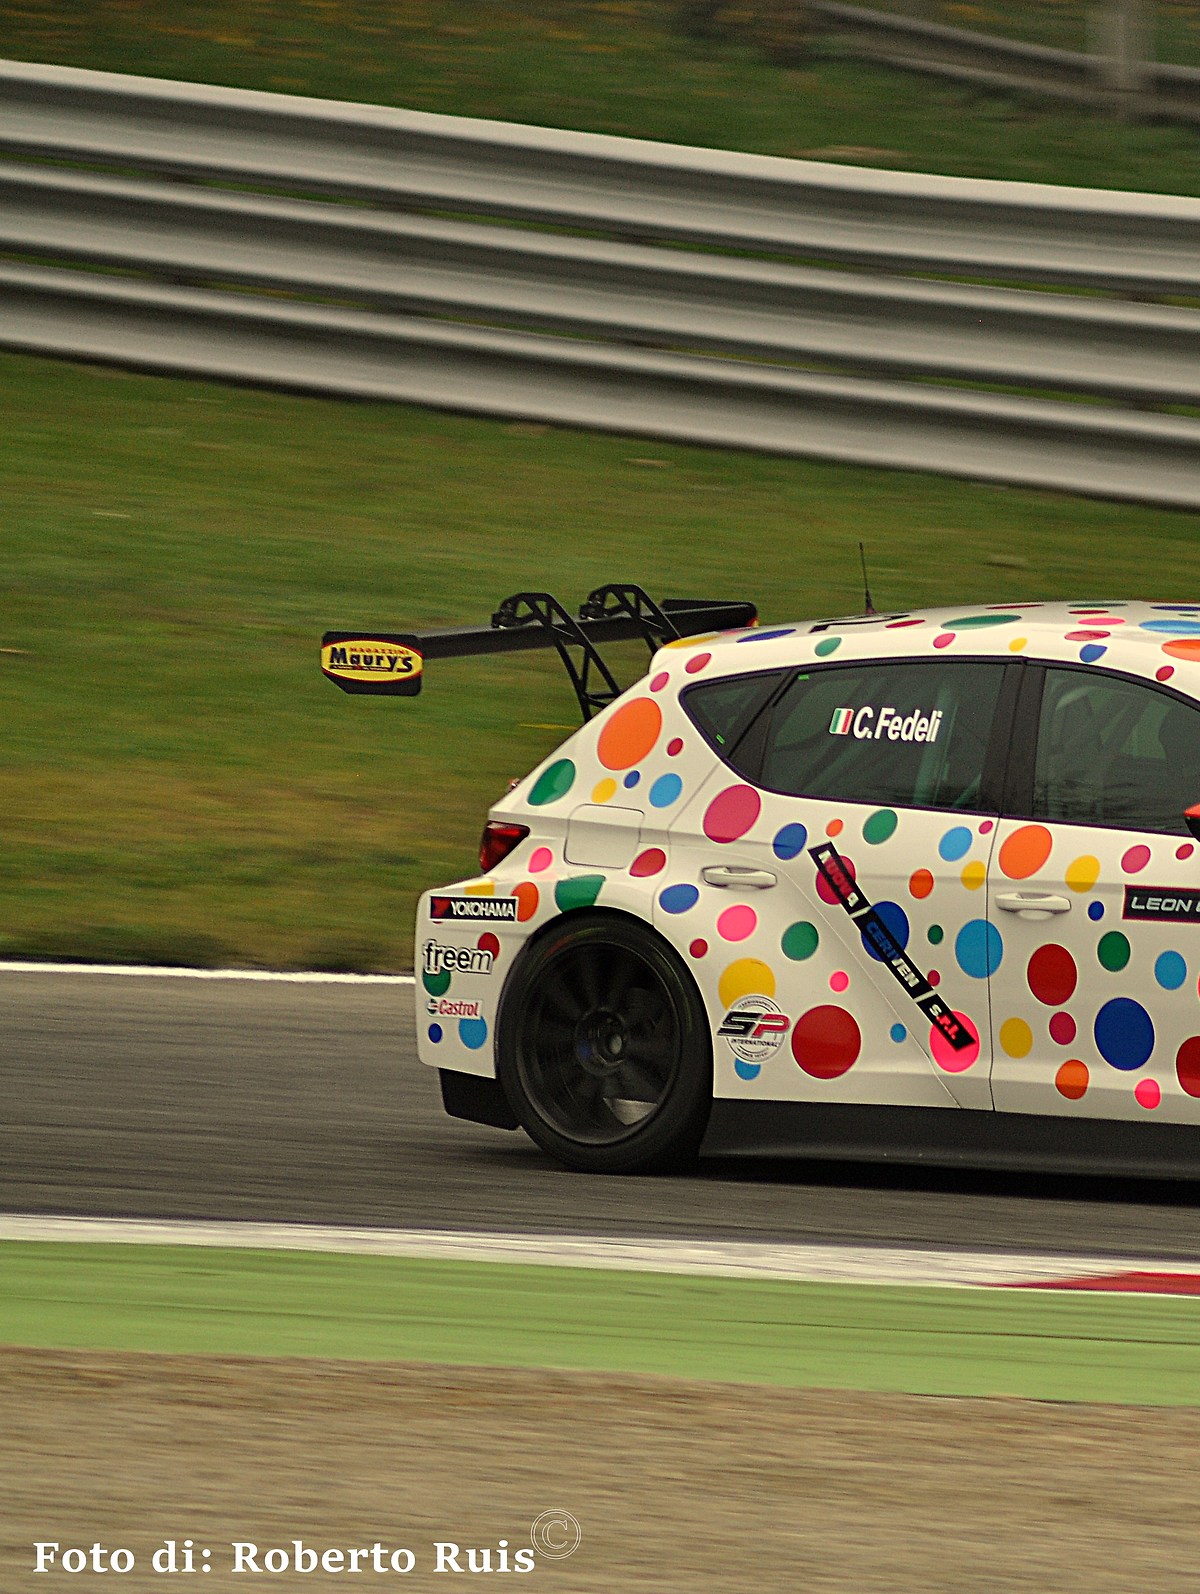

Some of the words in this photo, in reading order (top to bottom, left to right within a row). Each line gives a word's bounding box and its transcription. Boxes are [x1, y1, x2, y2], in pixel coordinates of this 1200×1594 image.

[450, 901, 515, 917] YOKOHAMA
[1131, 896, 1193, 912] LEON
[424, 941, 493, 973] freem
[440, 999, 479, 1016] Castrol
[717, 1011, 790, 1038] SP
